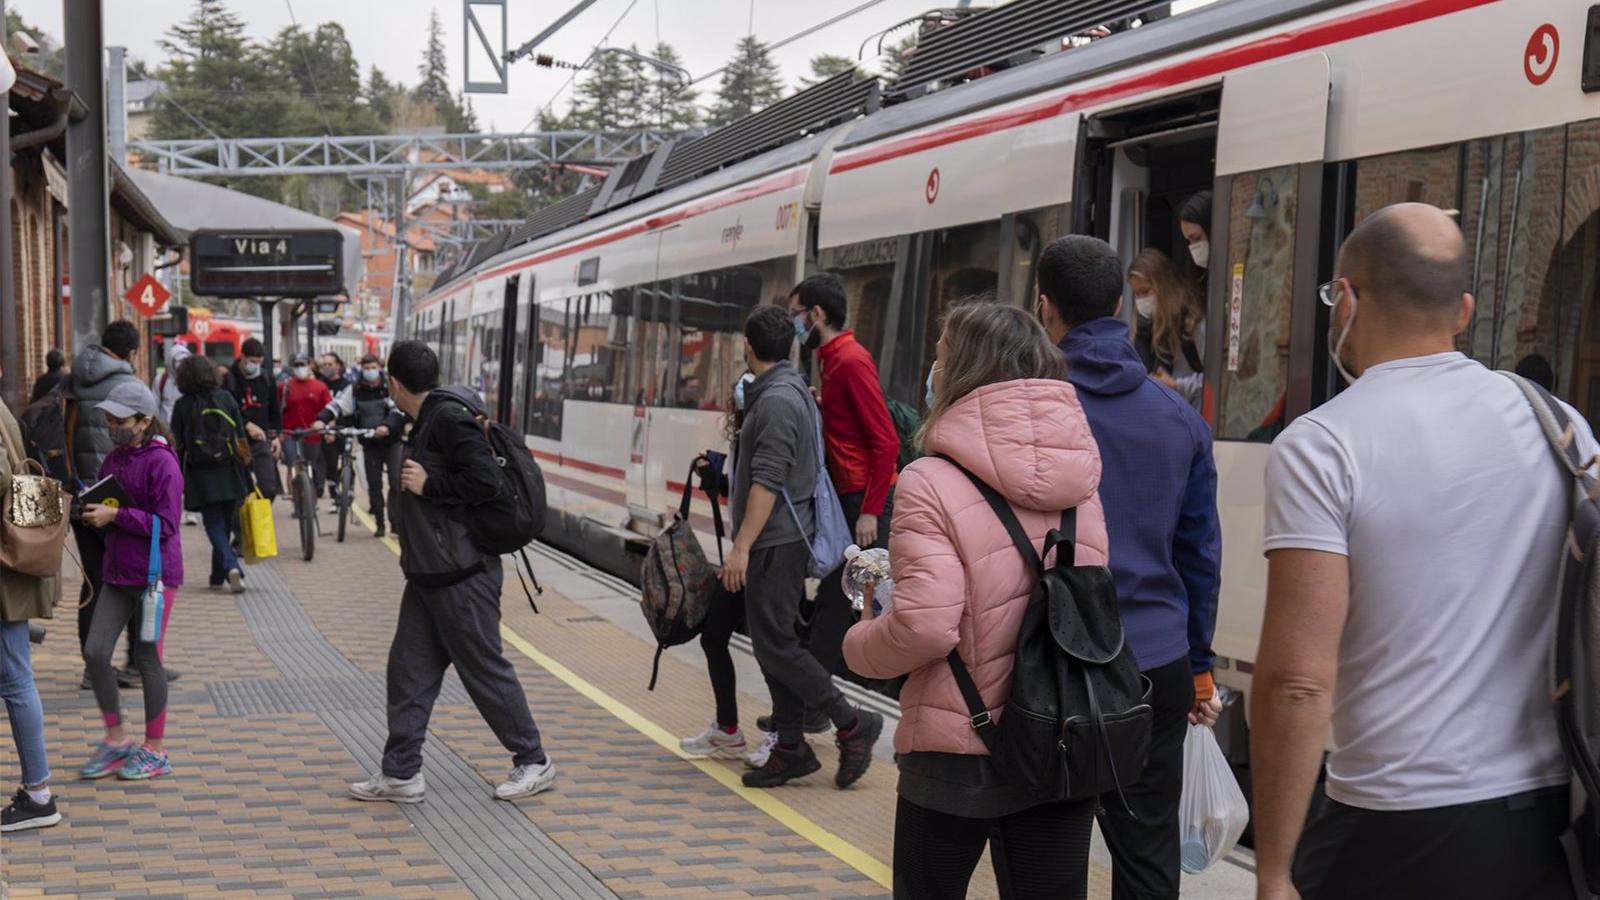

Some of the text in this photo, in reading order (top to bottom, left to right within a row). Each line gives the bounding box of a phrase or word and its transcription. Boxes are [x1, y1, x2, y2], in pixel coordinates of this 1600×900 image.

[721, 214, 743, 252] renfe
[276, 239, 287, 254] 4
[140, 283, 156, 308] 4
